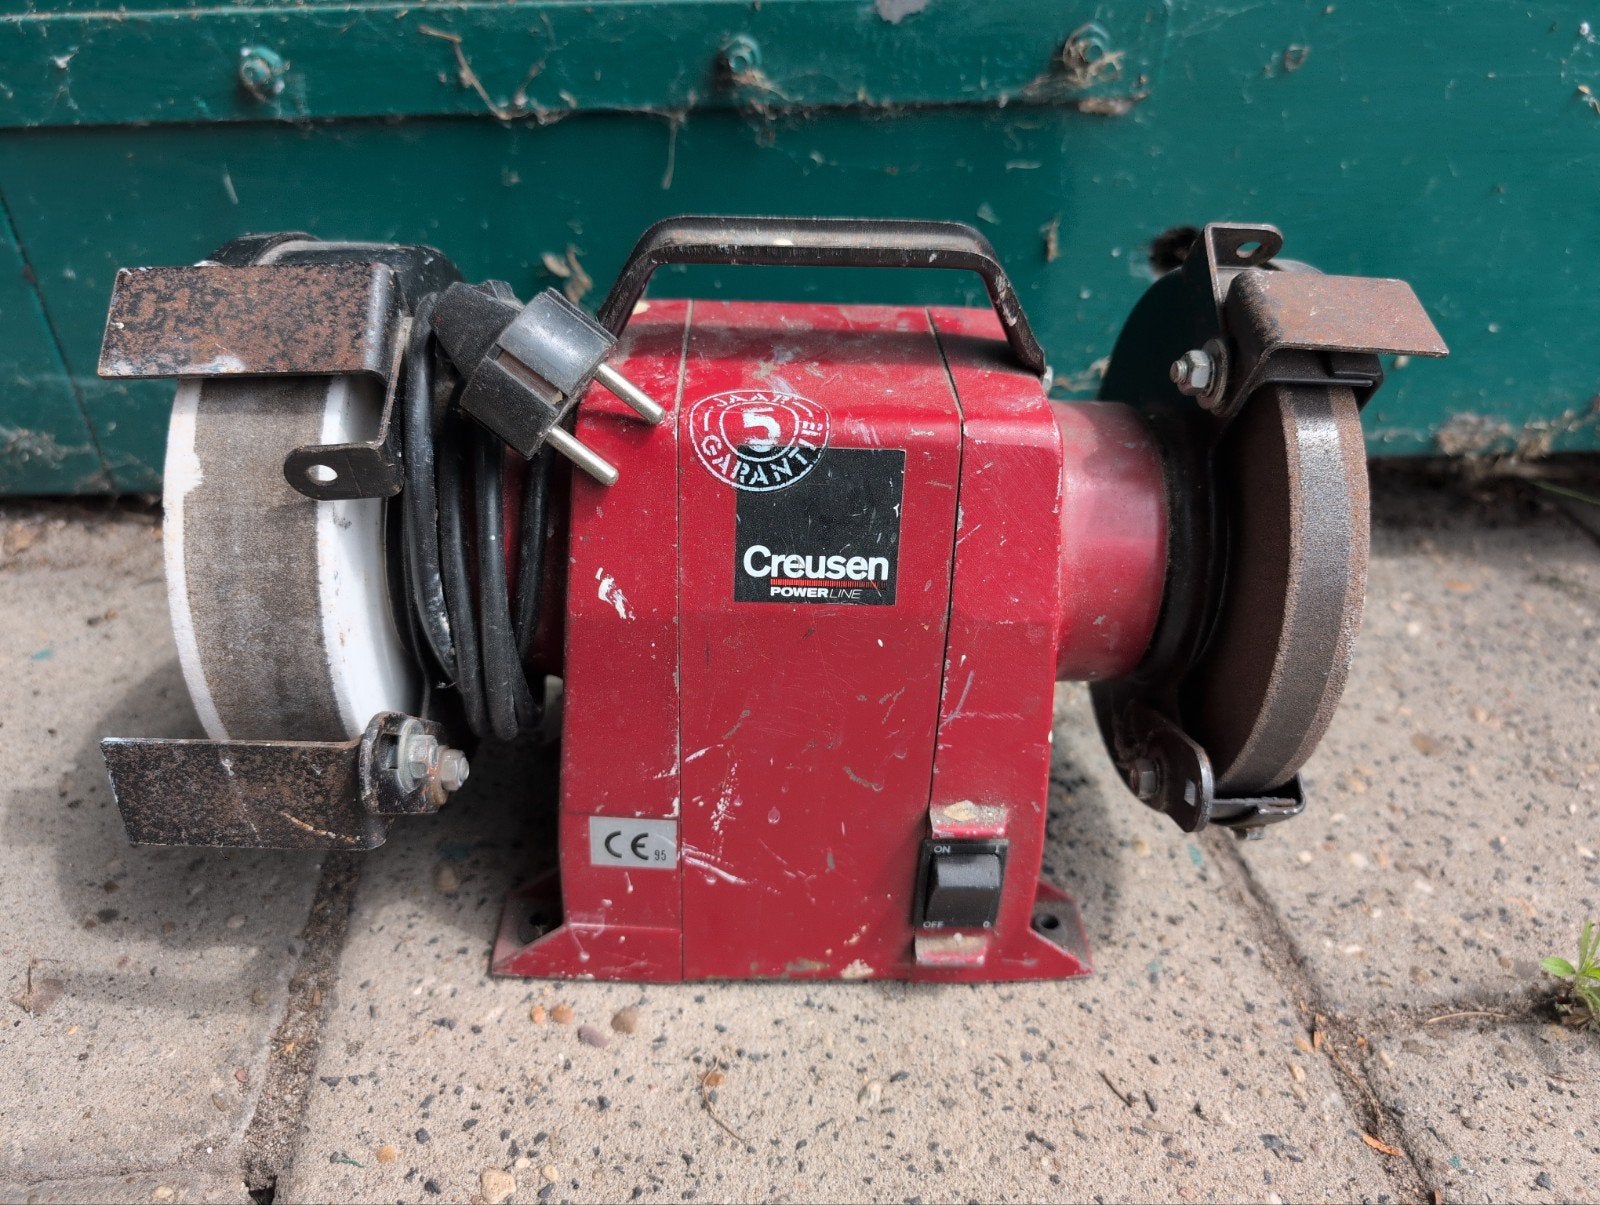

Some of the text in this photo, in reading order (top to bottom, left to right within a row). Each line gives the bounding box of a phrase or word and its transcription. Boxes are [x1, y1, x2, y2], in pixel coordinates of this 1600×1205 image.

[713, 393, 791, 406] JAAR
[742, 407, 781, 453] 5
[701, 419, 824, 485] GARANTIE
[743, 545, 889, 581] Creusen
[604, 830, 666, 861] CE 95
[933, 845, 951, 854] ON
[923, 920, 944, 928] OFF
